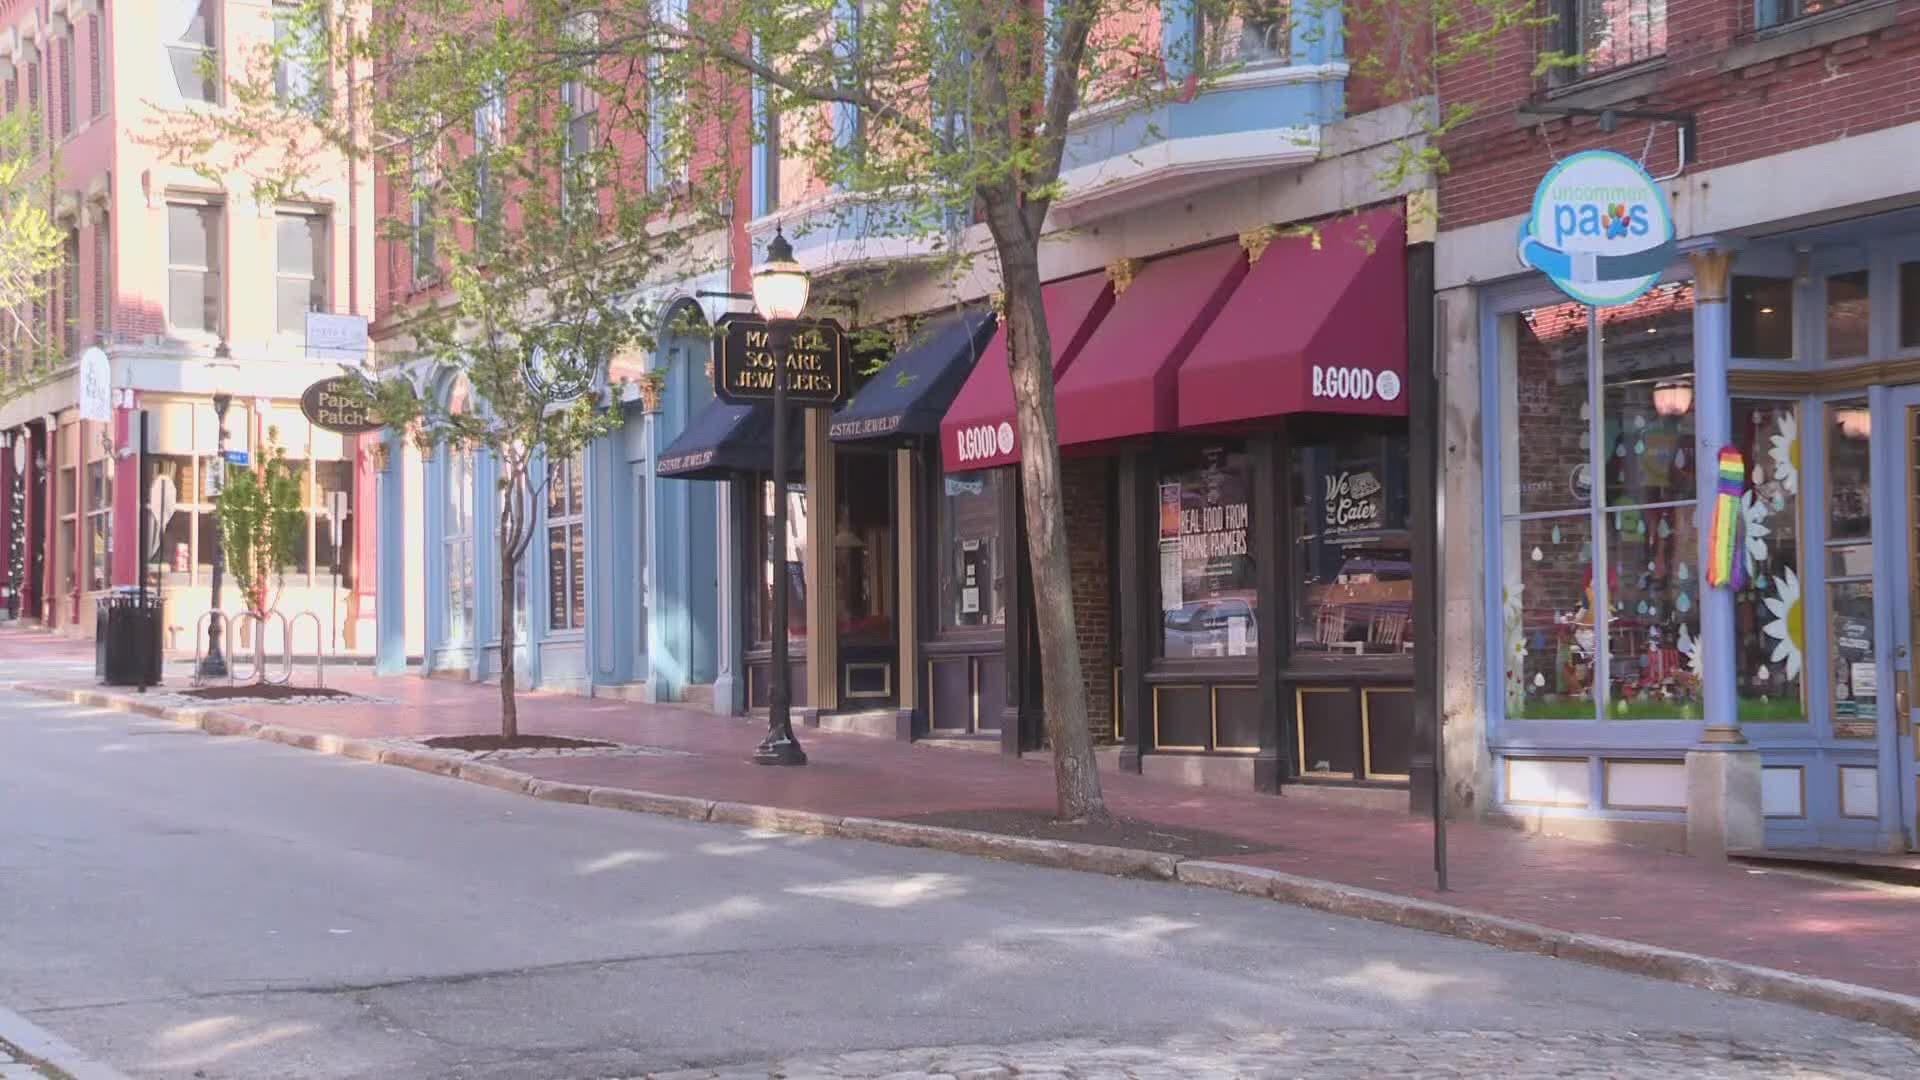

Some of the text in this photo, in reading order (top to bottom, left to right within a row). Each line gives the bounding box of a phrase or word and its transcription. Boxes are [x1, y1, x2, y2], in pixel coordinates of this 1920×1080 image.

[745, 351, 822, 371] SQARE
[735, 371, 832, 391] JEWLERS
[1312, 364, 1374, 400] B.GOOD
[319, 392, 364, 408] Paper
[319, 408, 364, 425] Patch
[831, 420, 861, 436] ESTATE
[957, 423, 997, 462] B.GOOD
[1324, 471, 1350, 501] We
[1203, 505, 1224, 532] FOOD
[1226, 502, 1249, 530] FROM
[1336, 498, 1377, 525] Cater
[1210, 529, 1248, 559] FARMERS
